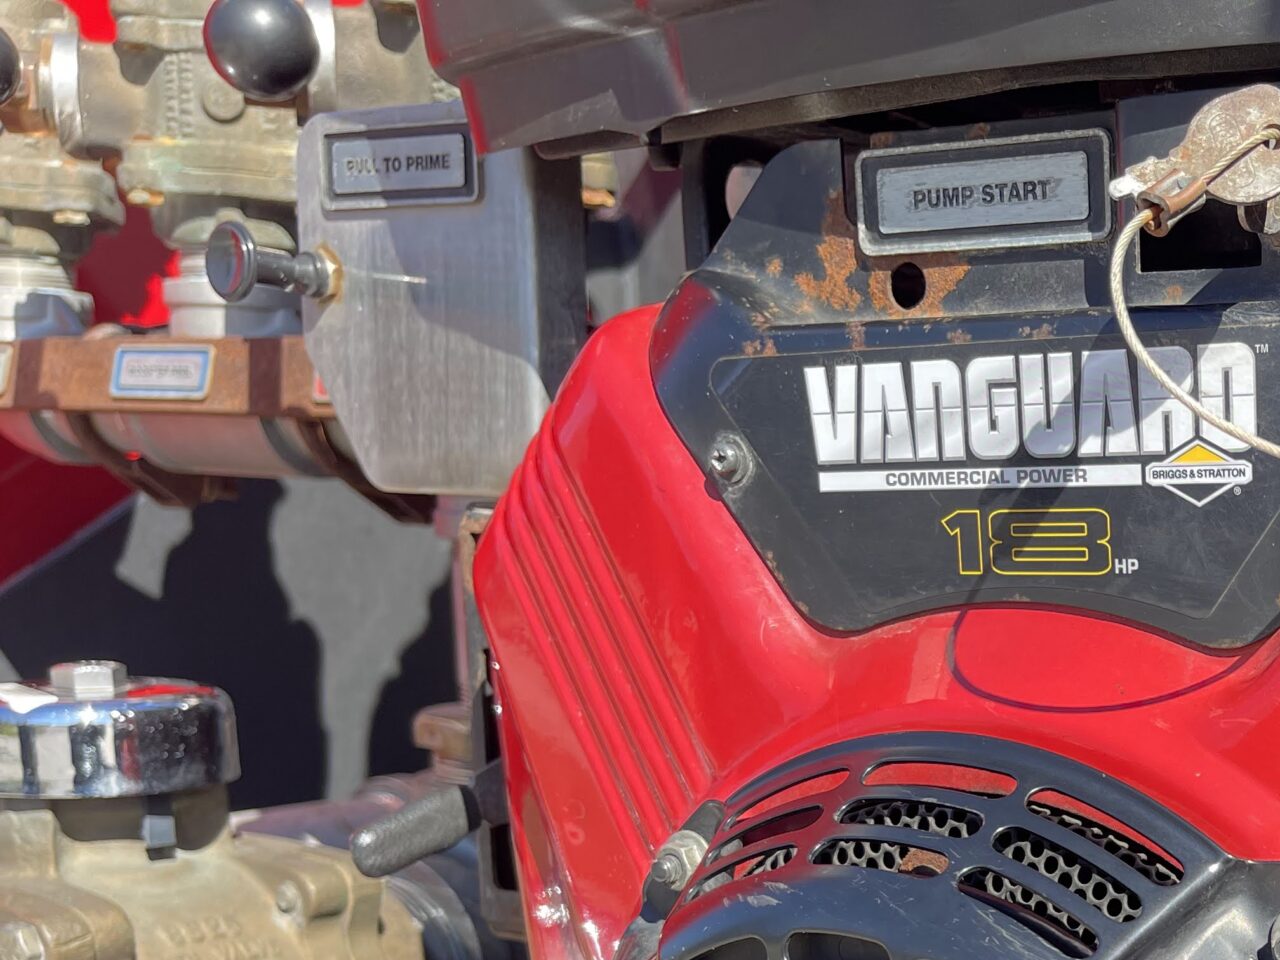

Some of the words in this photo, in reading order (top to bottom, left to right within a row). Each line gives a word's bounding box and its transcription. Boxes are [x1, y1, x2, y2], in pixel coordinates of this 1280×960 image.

[345, 157, 381, 176] PULL
[383, 156, 401, 173] TO
[406, 152, 450, 172] PRIME
[913, 187, 974, 210] PUMP
[981, 179, 1050, 204] START
[803, 342, 1258, 465] VANGUARD
[885, 469, 1010, 487] COMMERCIAL
[1016, 467, 1089, 485] POWER
[1152, 469, 1188, 480] BRIGGS
[1197, 467, 1246, 478] STRATTON
[940, 508, 1113, 576] 18
[1115, 558, 1139, 575] HP
